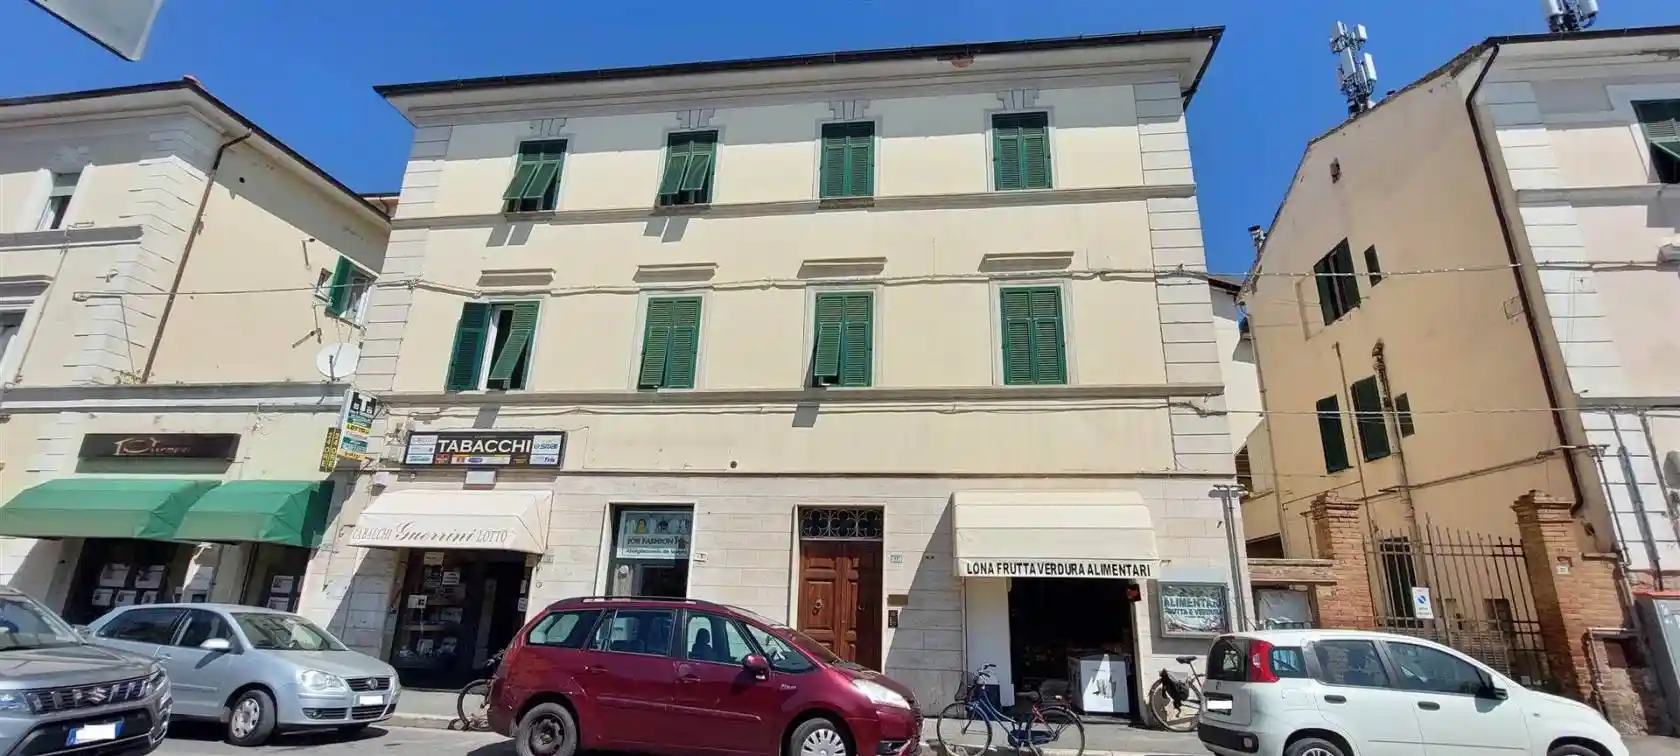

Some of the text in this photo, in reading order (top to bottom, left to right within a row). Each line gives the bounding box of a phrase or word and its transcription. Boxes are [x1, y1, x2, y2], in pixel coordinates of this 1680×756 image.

[438, 440, 532, 453] TABACCHI
[352, 520, 508, 543] TABACCHI Guerrini LOTTO
[967, 562, 1151, 577] LONA FRUTTA VERDURA ALIMENTARI
